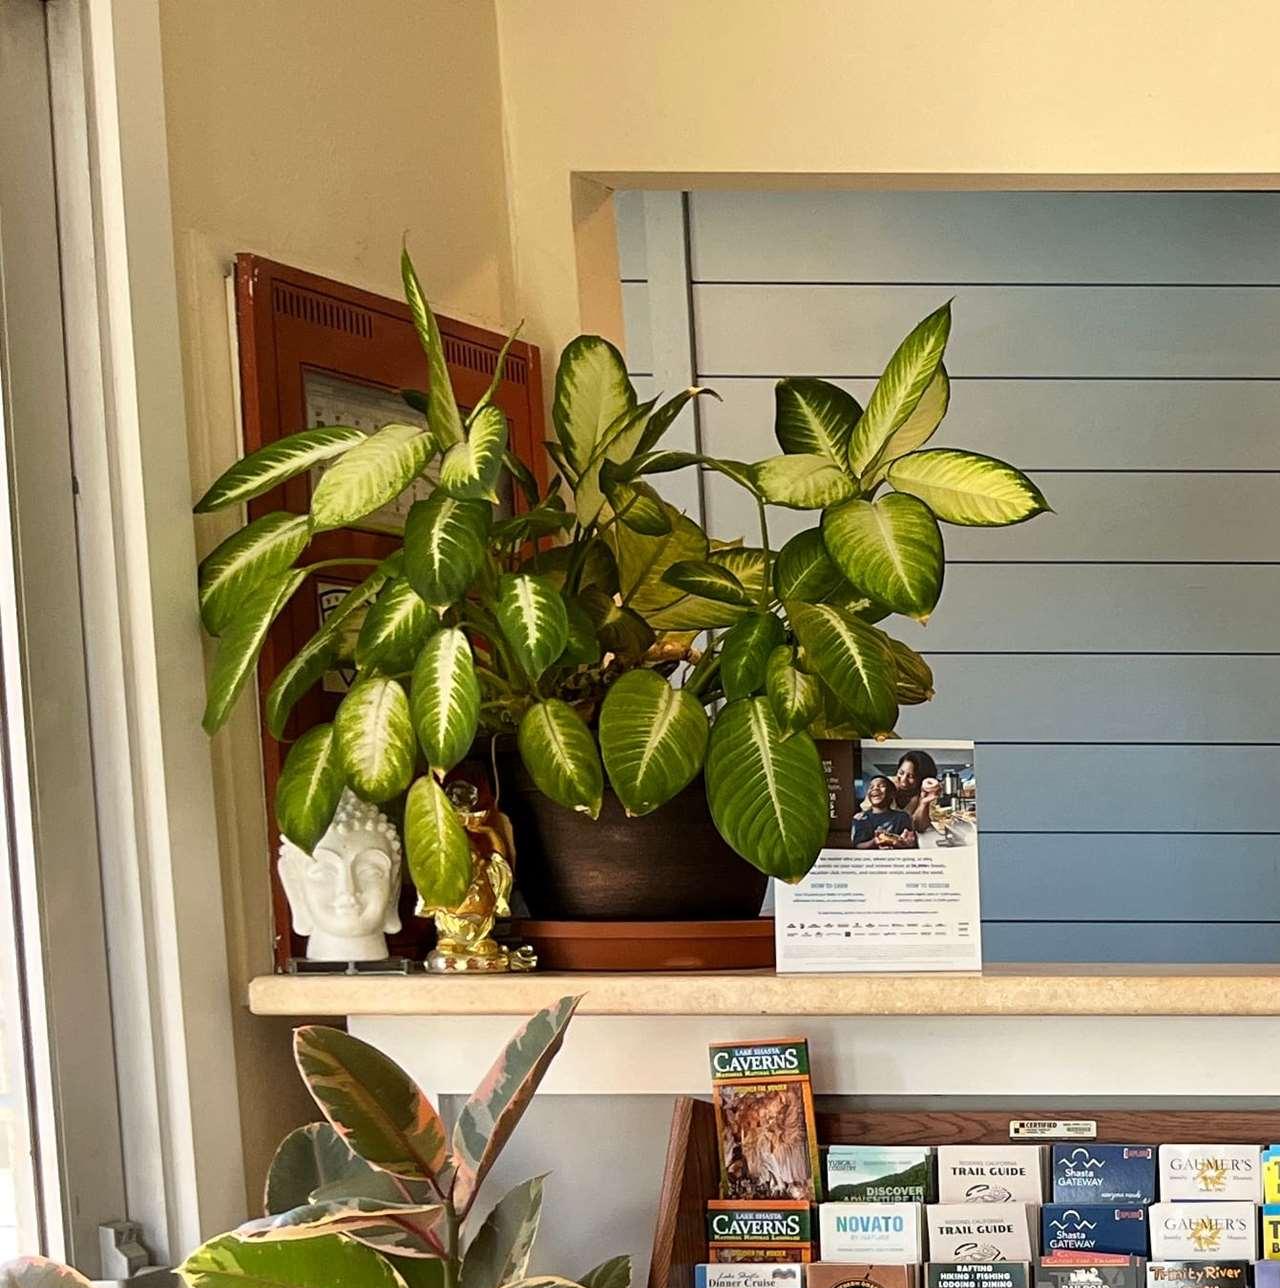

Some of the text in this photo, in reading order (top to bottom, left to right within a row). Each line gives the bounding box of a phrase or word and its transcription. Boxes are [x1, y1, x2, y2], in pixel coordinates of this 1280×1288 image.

[713, 1048, 798, 1074] CAVERNS
[1169, 1157, 1253, 1171] GAUMER'S
[951, 1167, 1027, 1176] TRAIL GUIDE
[1065, 1168, 1094, 1178] Shasta
[1058, 1177, 1104, 1187] GATEWAY
[866, 1187, 924, 1196] DISCOVER
[712, 1214, 800, 1236] CAVERNS
[836, 1216, 904, 1233] NOVATO
[937, 1225, 1014, 1235] TRAIL GUIDE
[1050, 1240, 1096, 1249] GATEWAY
[956, 1264, 993, 1272] RAFTING
[940, 1272, 1011, 1280] HIKING FISHING
[1149, 1265, 1241, 1283] Trinity River
[708, 1278, 776, 1287] Dinner Cruise
[938, 1280, 1013, 1288] LODGING DINING
